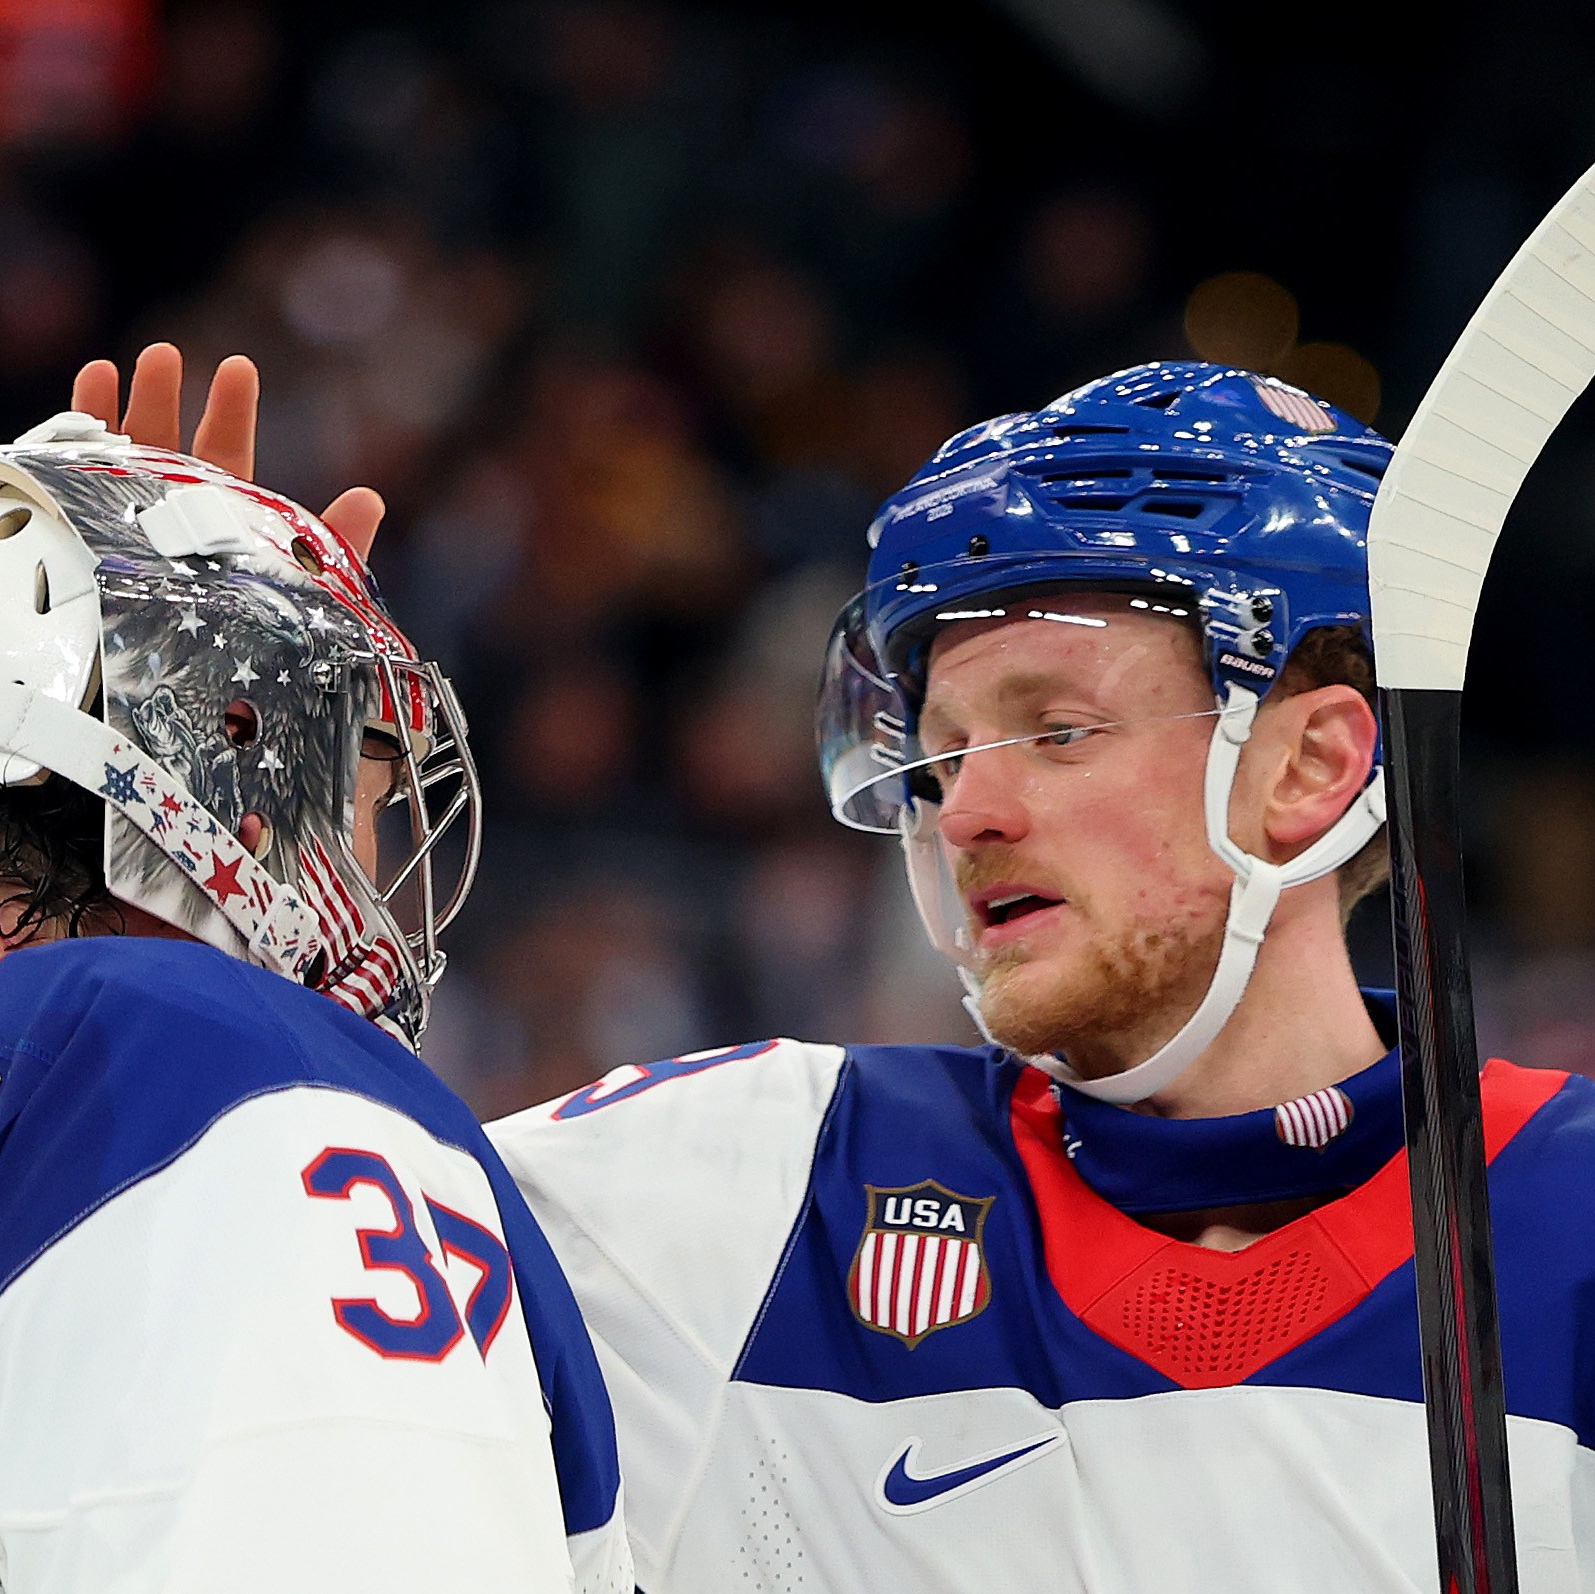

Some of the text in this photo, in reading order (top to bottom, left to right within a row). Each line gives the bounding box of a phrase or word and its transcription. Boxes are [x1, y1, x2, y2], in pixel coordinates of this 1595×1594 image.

[1219, 653, 1276, 679] BAUER
[883, 1196, 966, 1233] USA
[300, 1146, 513, 1368] 37
